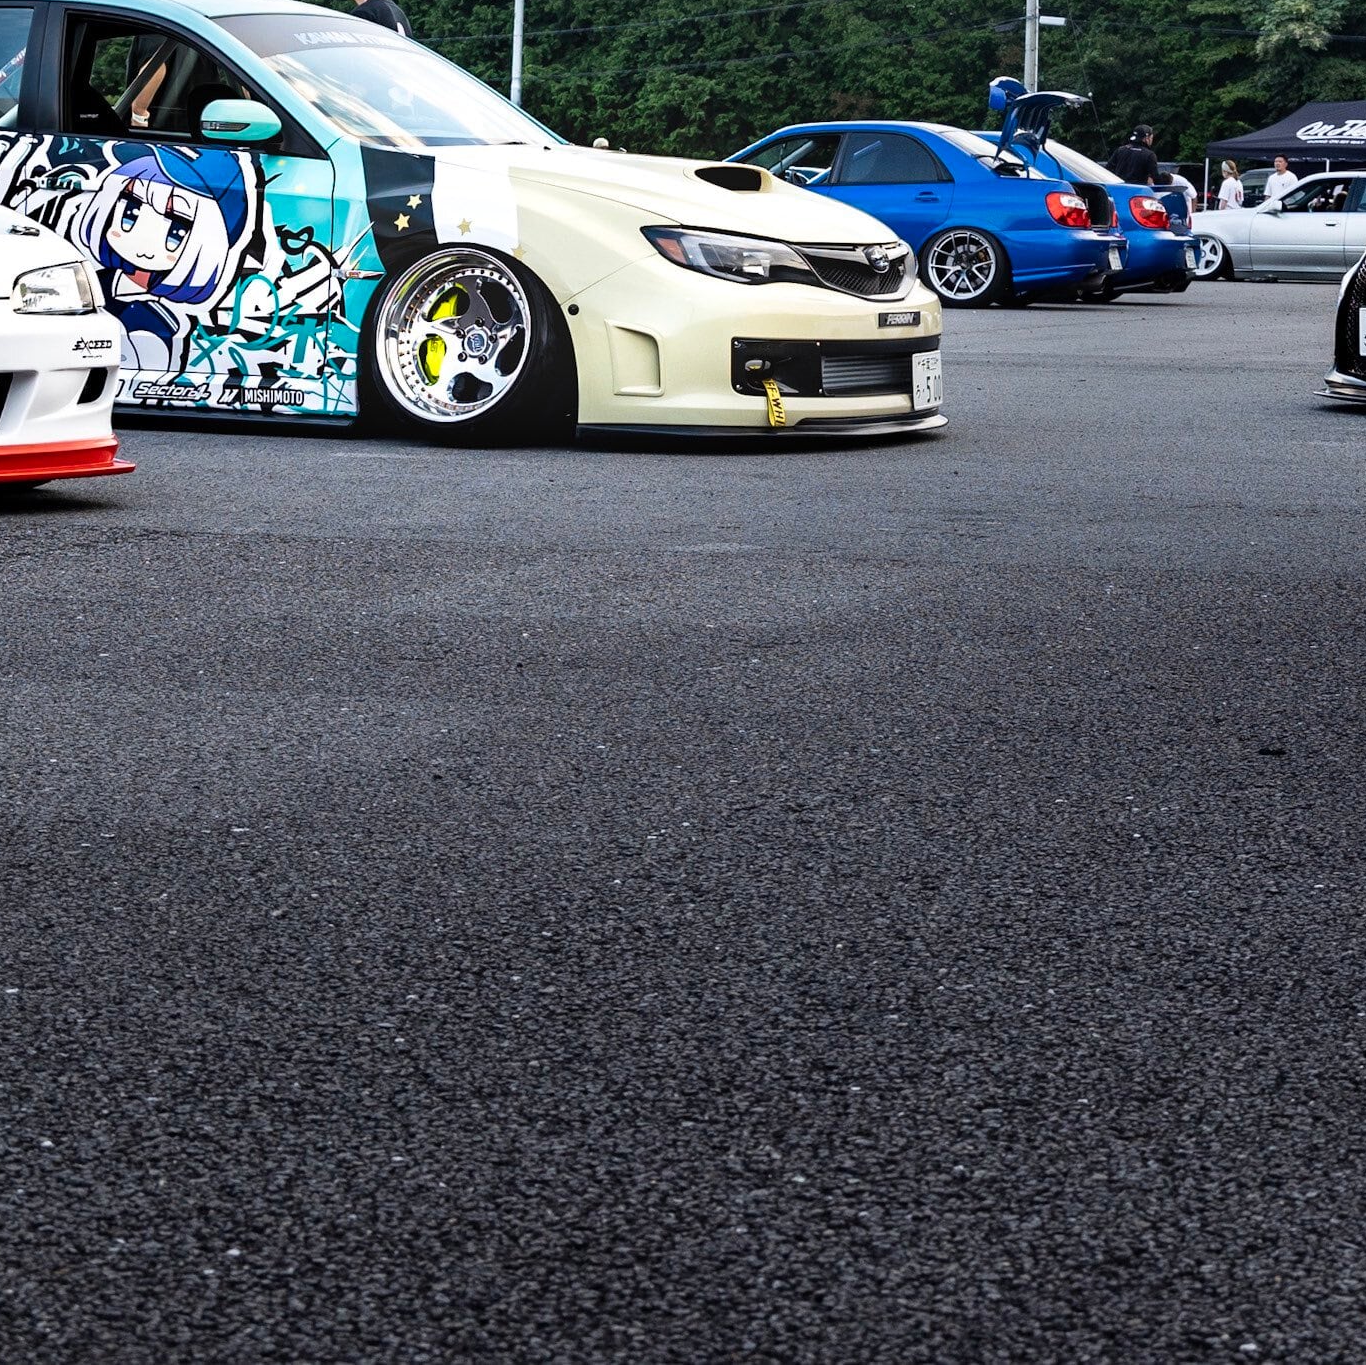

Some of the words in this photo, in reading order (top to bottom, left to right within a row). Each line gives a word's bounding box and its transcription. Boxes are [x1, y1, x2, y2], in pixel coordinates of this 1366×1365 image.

[886, 313, 914, 325] PERRIN
[72, 337, 112, 354] EXCEED
[244, 389, 304, 405] MISHIMOTO
